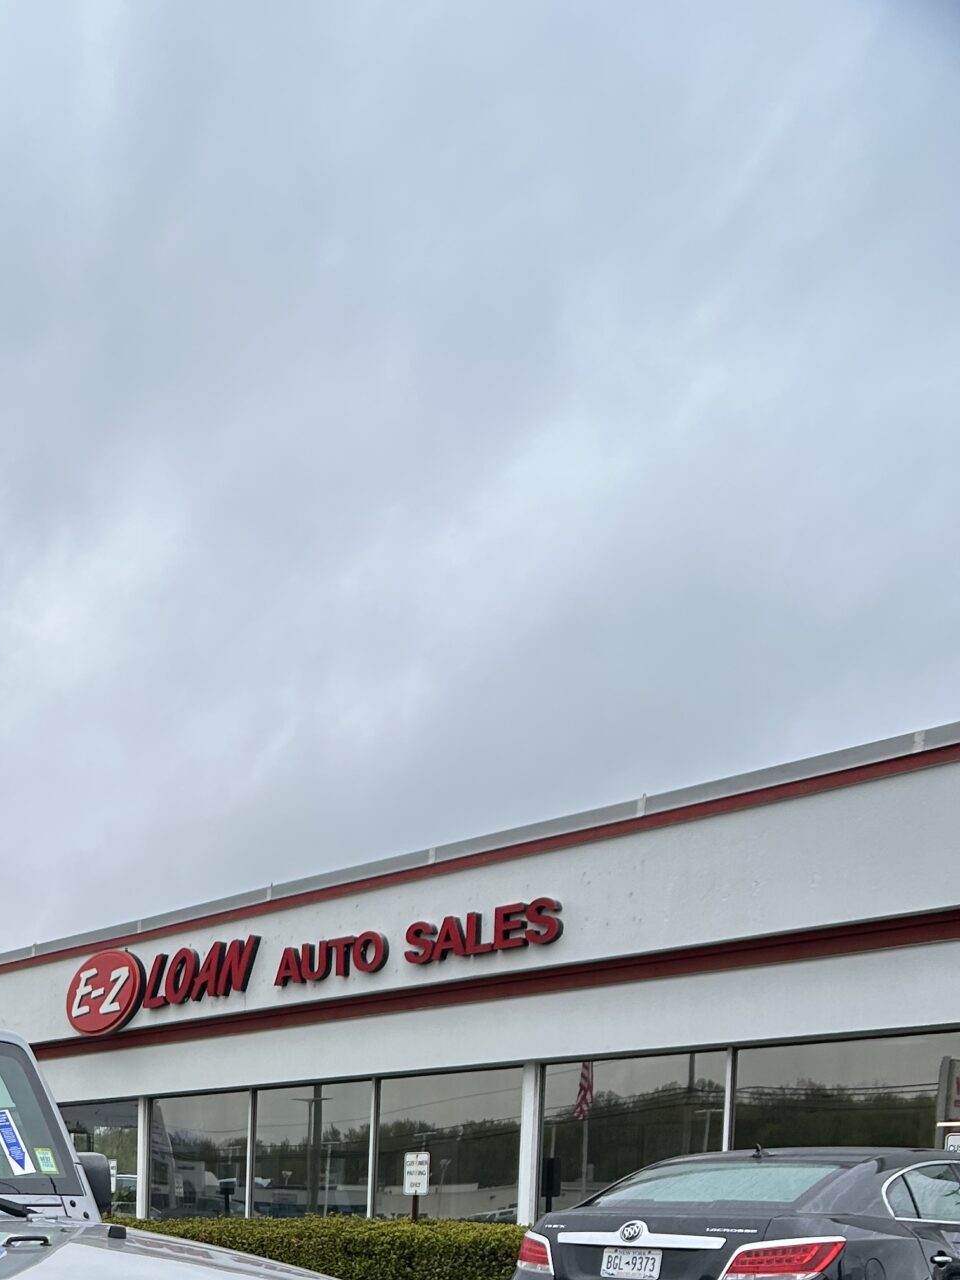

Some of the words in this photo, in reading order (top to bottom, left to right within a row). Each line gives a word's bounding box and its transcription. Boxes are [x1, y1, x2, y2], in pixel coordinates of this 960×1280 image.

[71, 966, 130, 1018] E-Z
[142, 934, 260, 1009] LOAN
[274, 931, 390, 986] AUTO
[404, 897, 564, 965] SALES
